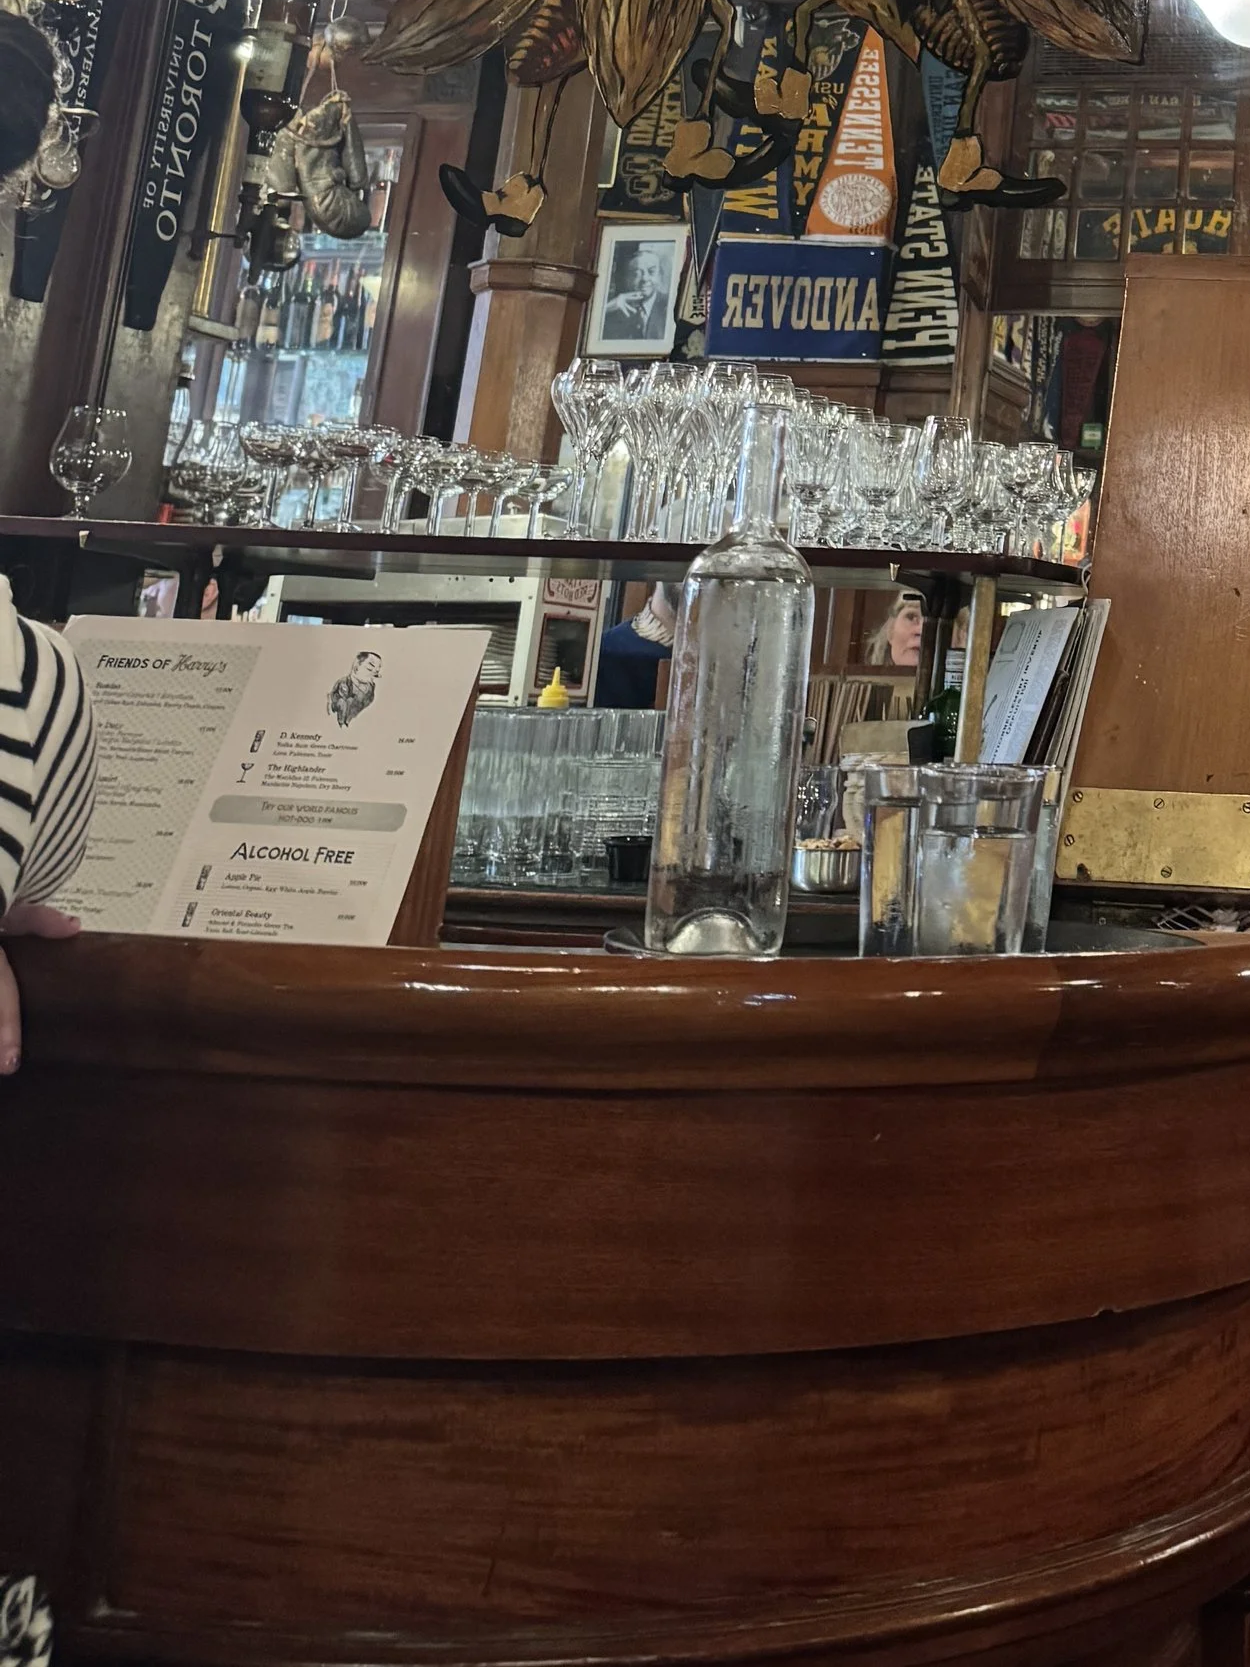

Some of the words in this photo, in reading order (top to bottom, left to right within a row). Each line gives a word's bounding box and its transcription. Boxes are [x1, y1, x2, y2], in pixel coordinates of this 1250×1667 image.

[96, 654, 150, 670] FRIENDS
[152, 659, 172, 670] OF
[268, 764, 282, 772] The
[283, 764, 326, 774] Highlander
[230, 842, 310, 862] ALCOHOL
[314, 846, 355, 865] FREE
